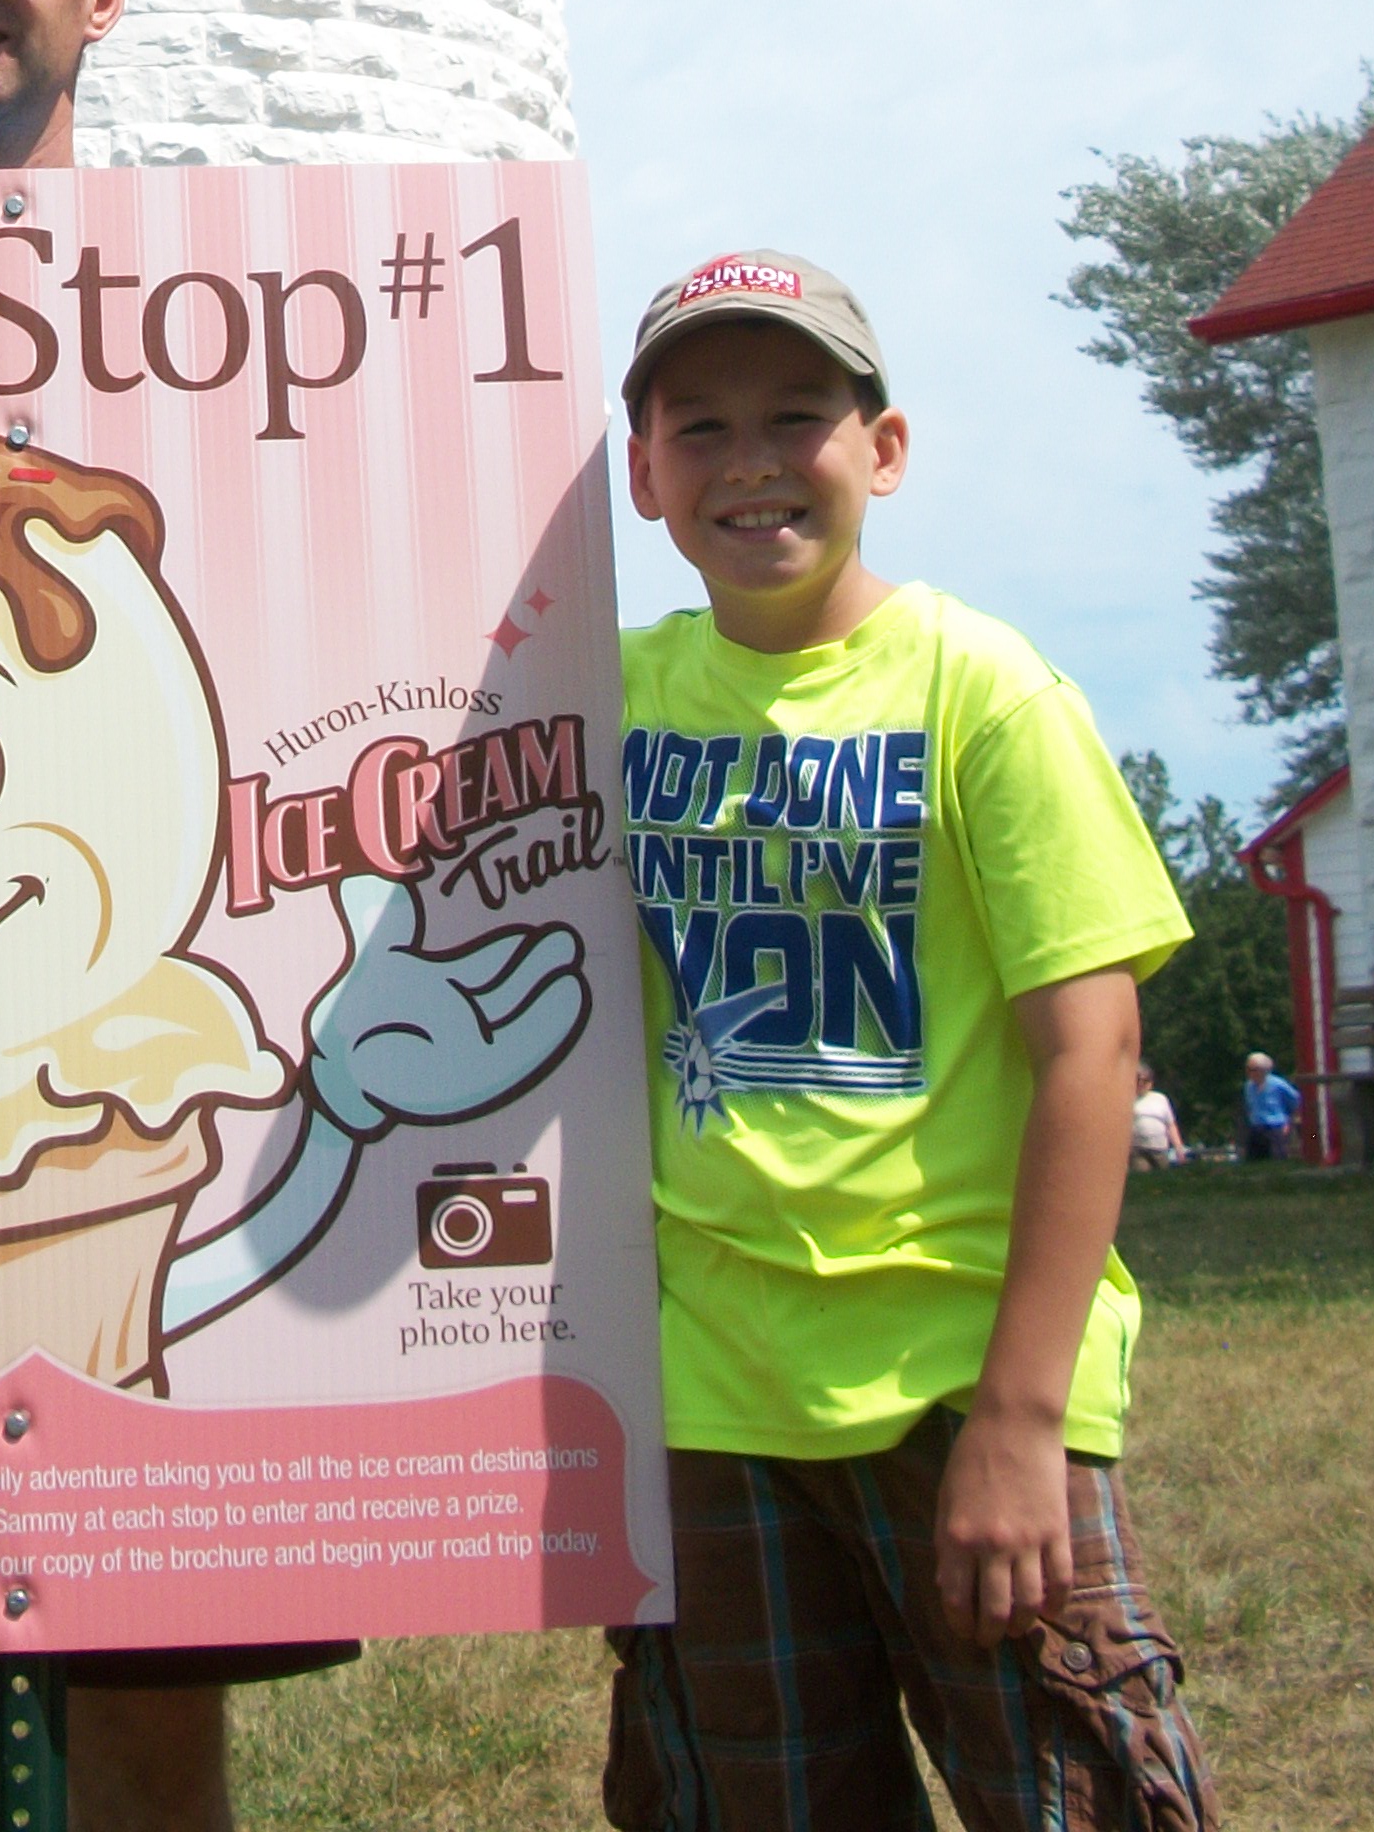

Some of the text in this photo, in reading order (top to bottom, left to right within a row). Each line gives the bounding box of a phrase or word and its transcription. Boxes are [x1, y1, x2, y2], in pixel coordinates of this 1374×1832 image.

[686, 265, 795, 292] CLINTON
[263, 676, 503, 768] Huron-Kinloss
[622, 727, 929, 832] NOT DONE
[226, 719, 582, 912] ICE CREAM
[439, 791, 611, 910] Trail
[788, 837, 923, 908] I'VE
[408, 1280, 563, 1315] Take your
[399, 1315, 576, 1356] photo here.
[30, 1464, 137, 1491] adventure
[143, 1461, 210, 1489] taking
[218, 1461, 255, 1489] you
[262, 1458, 282, 1482] to
[288, 1455, 311, 1481] all
[318, 1454, 352, 1480] the
[359, 1453, 389, 1477] ice
[396, 1454, 464, 1476] cream
[470, 1445, 598, 1474] destinations
[84, 1506, 106, 1531] at
[112, 1503, 165, 1530] each
[171, 1504, 218, 1531] stop
[225, 1501, 246, 1526] to
[251, 1499, 309, 1524] enter
[314, 1496, 355, 1522] and
[362, 1492, 440, 1520] receive
[446, 1495, 460, 1516] a
[466, 1489, 524, 1519] prize.
[43, 1552, 94, 1579] copy
[101, 1548, 122, 1571] of
[129, 1547, 163, 1571] the
[171, 1542, 267, 1570] brochure
[275, 1539, 315, 1566] and
[322, 1537, 382, 1567] begin
[388, 1537, 435, 1565] your
[442, 1531, 490, 1559] road
[497, 1530, 532, 1559] trip
[540, 1527, 602, 1557] today.
